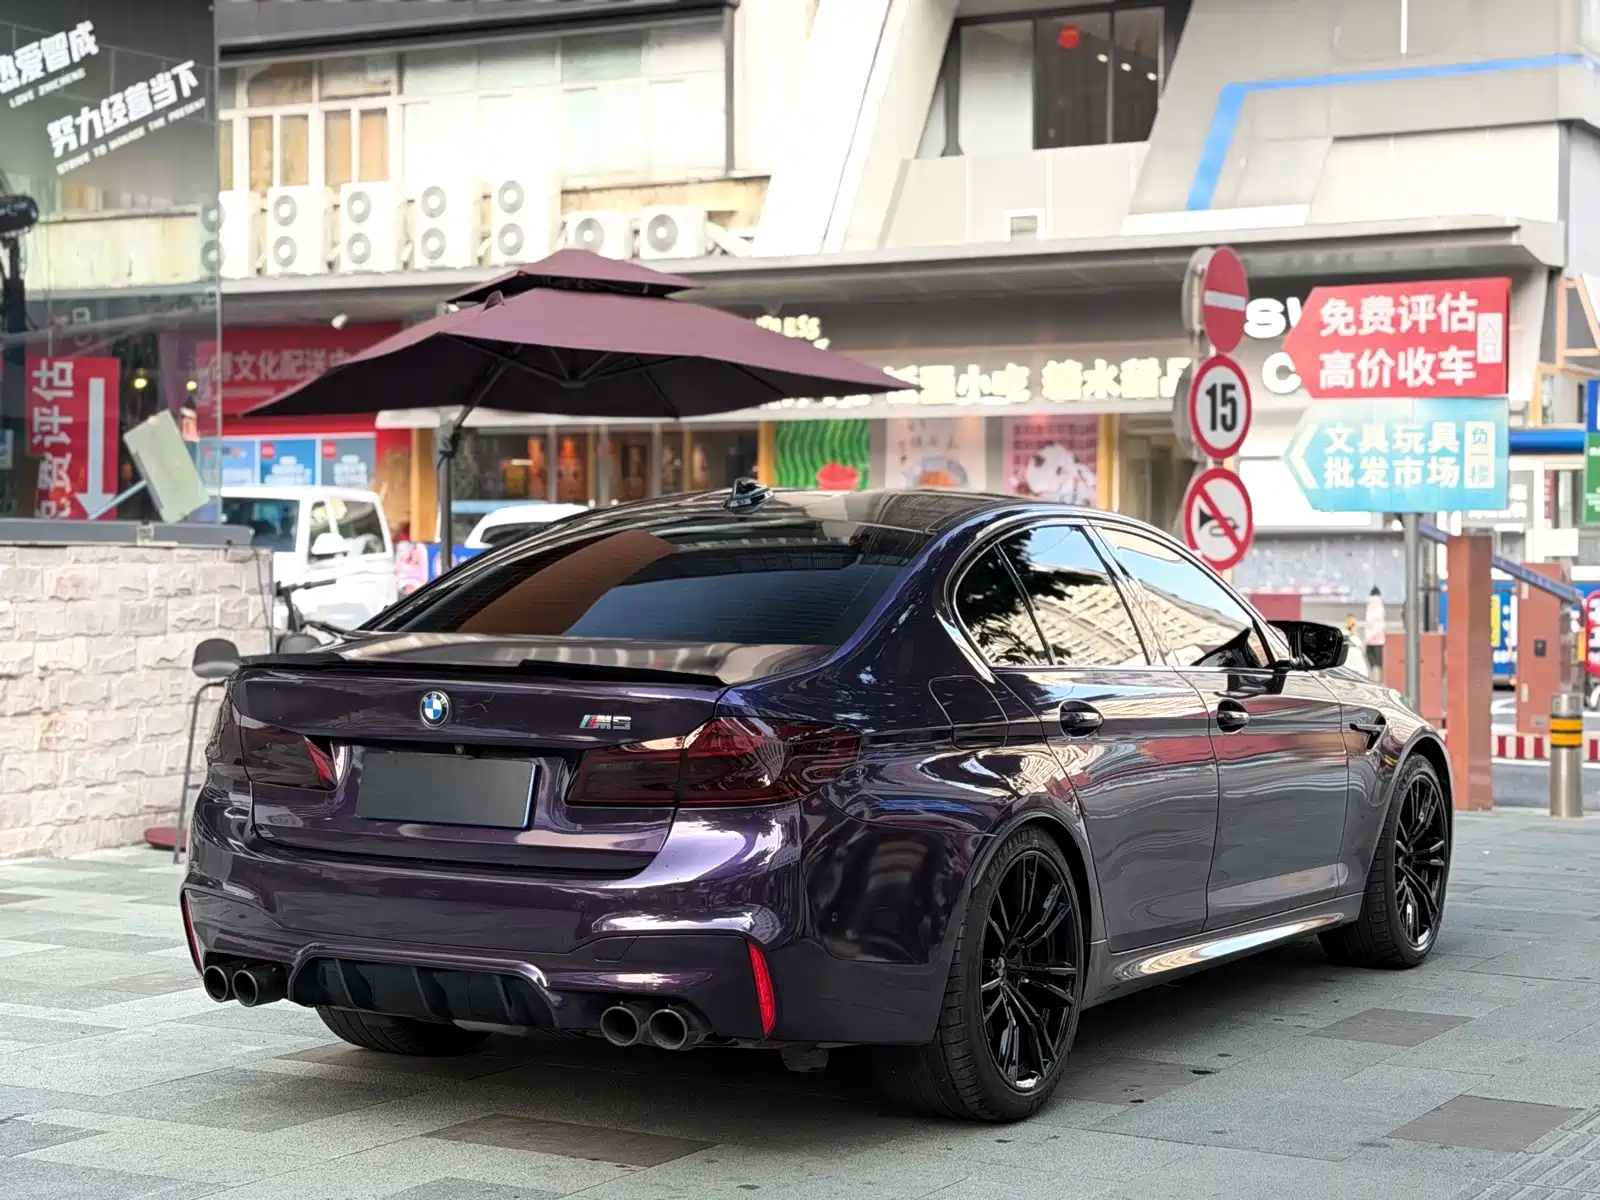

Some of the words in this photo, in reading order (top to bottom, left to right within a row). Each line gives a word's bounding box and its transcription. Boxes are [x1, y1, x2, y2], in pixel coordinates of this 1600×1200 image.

[47, 60, 199, 158] 努力经营当下
[1320, 292, 1478, 336] 免费评估
[1319, 346, 1477, 390] 高价收车
[1205, 382, 1237, 432] 15
[1324, 420, 1460, 454] 文具玩具
[1324, 455, 1461, 489] 批发市场
